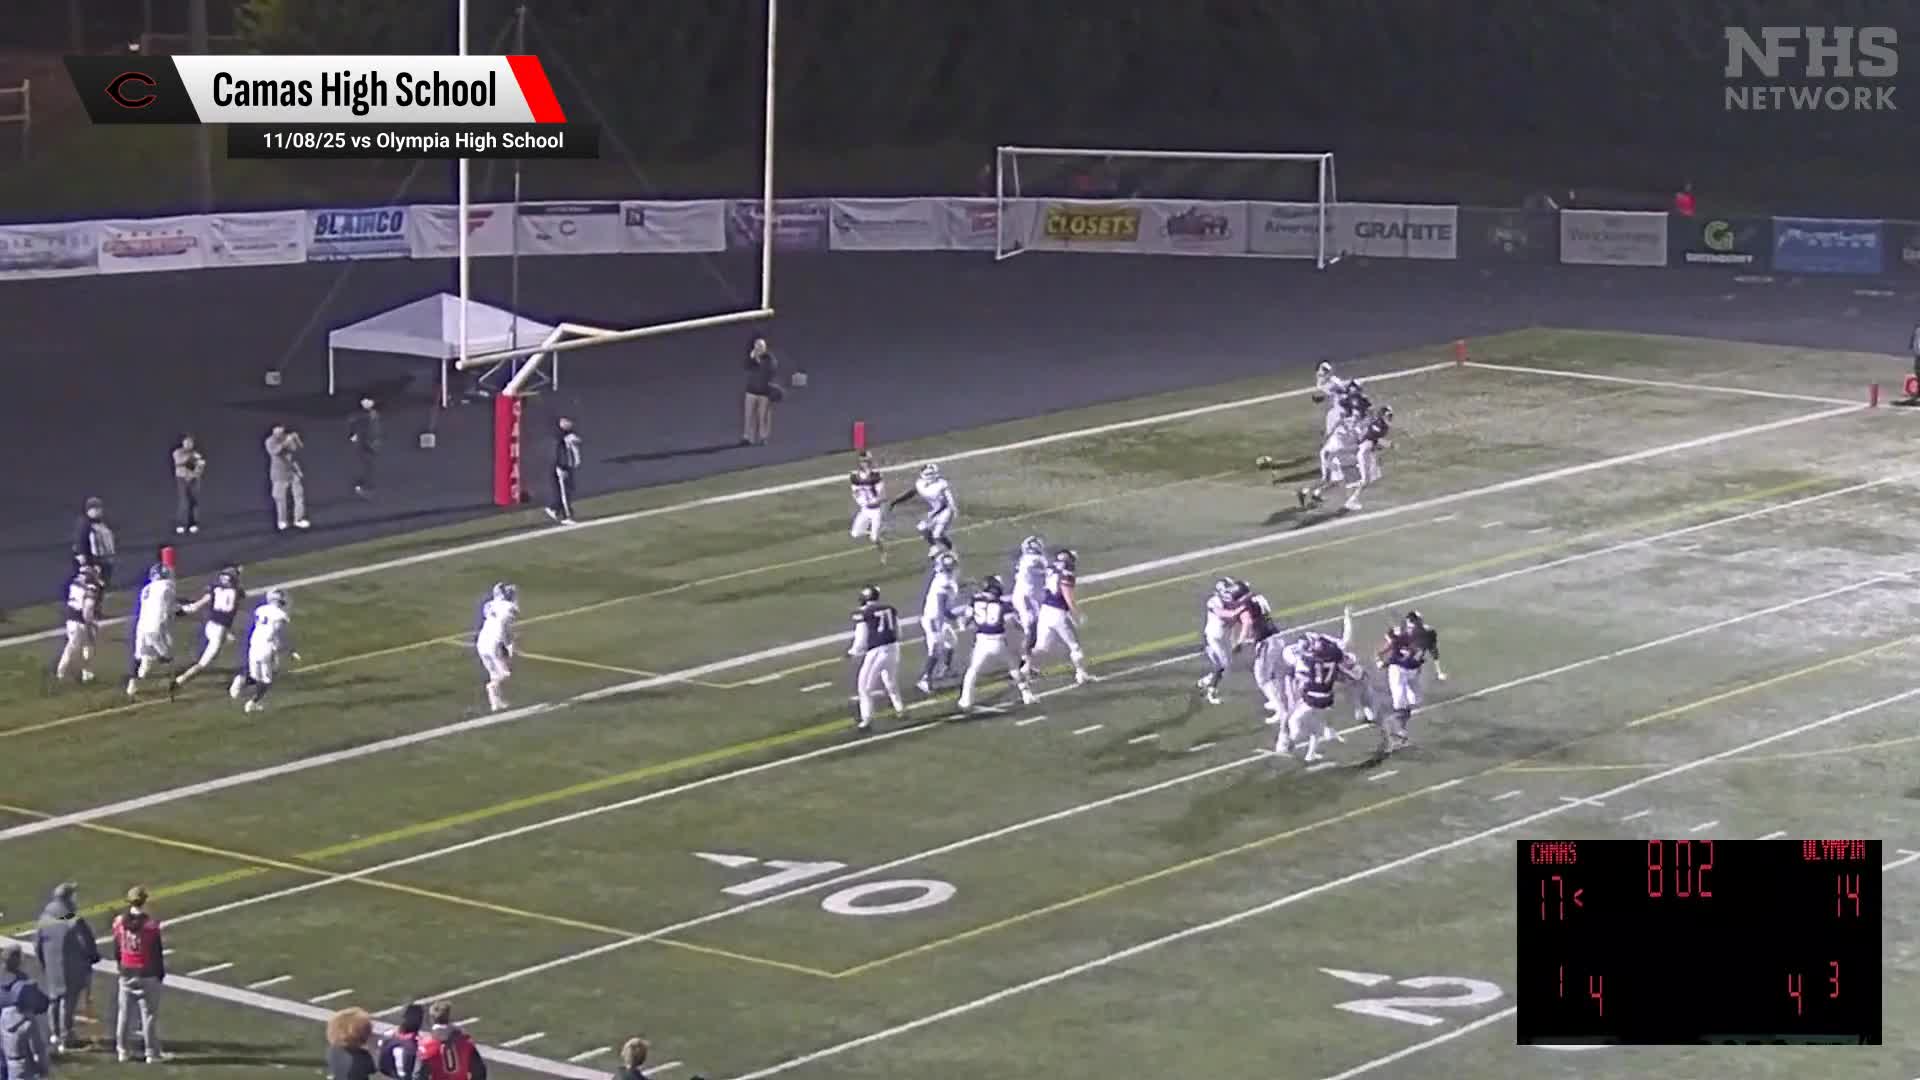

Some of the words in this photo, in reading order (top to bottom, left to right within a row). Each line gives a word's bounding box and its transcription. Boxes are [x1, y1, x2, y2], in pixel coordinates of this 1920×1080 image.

[1047, 215, 1136, 234] CLOSETS
[1354, 221, 1452, 241] GRANITE
[873, 608, 894, 632] 71
[1313, 661, 1337, 685] 17
[720, 859, 958, 916] 10
